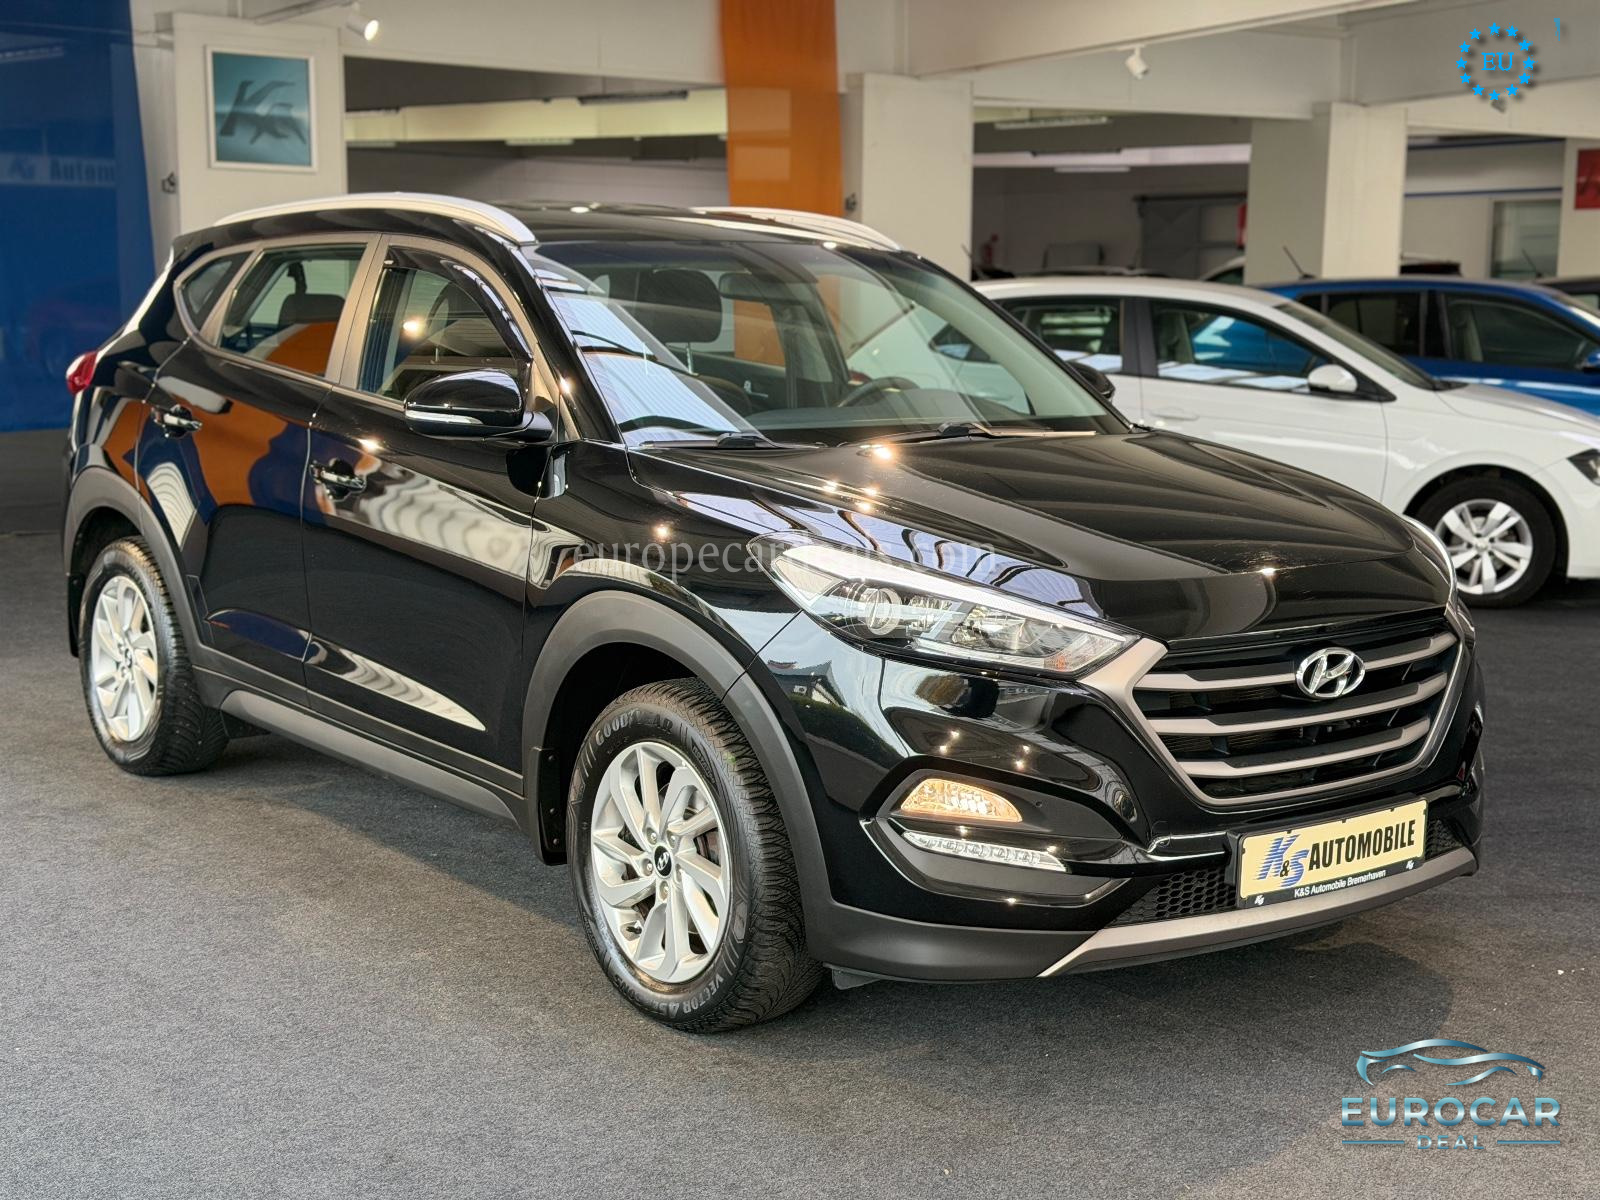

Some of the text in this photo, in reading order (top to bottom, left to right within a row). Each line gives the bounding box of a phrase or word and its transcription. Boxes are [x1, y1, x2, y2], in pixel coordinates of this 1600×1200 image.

[1308, 819, 1416, 871] AUTOMOBILE
[1294, 870, 1387, 898] K&S Automobile Bremerhaven
[683, 974, 724, 1013] VECTOR
